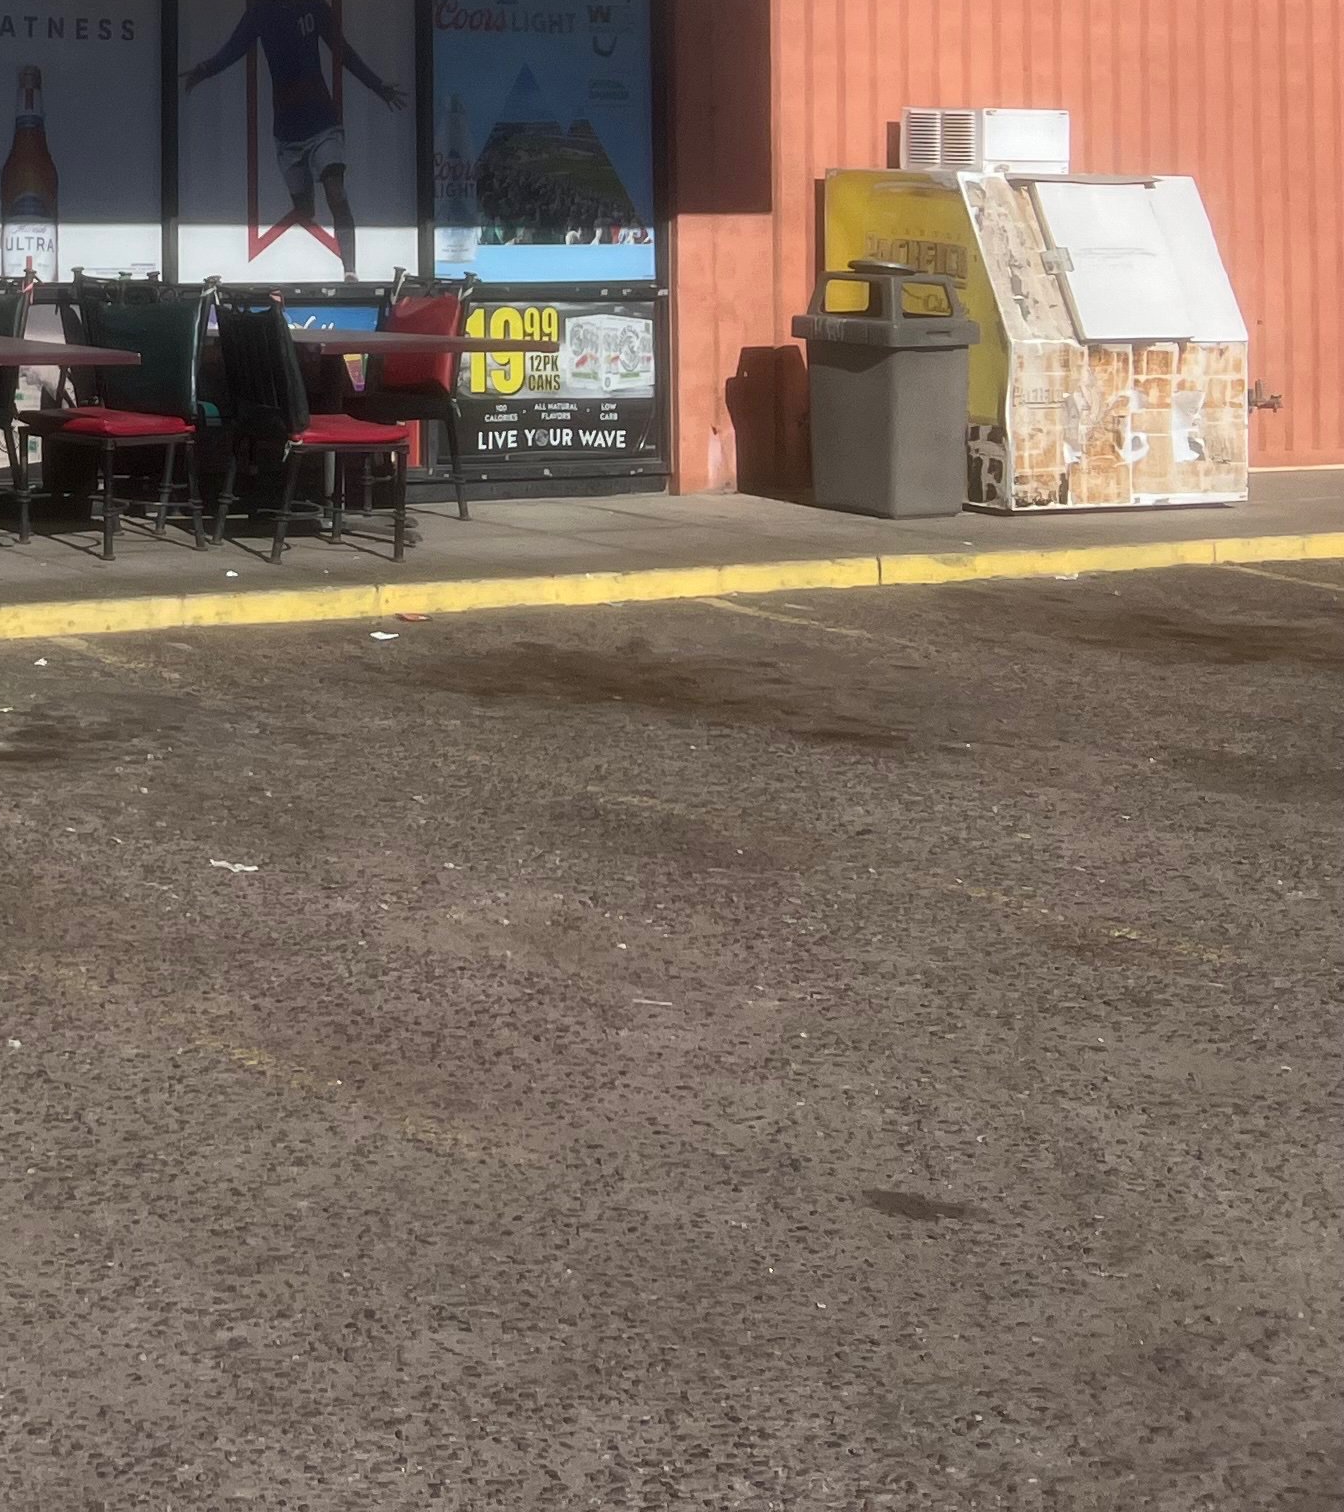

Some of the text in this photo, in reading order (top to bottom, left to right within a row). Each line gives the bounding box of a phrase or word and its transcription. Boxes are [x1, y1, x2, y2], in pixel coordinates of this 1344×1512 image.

[512, 12, 577, 34] LIGHT
[5, 236, 54, 253] ULTRA
[529, 354, 559, 372] 12PK
[528, 374, 561, 392] CANS
[534, 403, 547, 411] ALL
[600, 402, 617, 411] LOW
[484, 414, 518, 423] CALORIES
[541, 412, 571, 420] FLAVORS
[478, 428, 627, 450] LIVE YOUR WAVE
